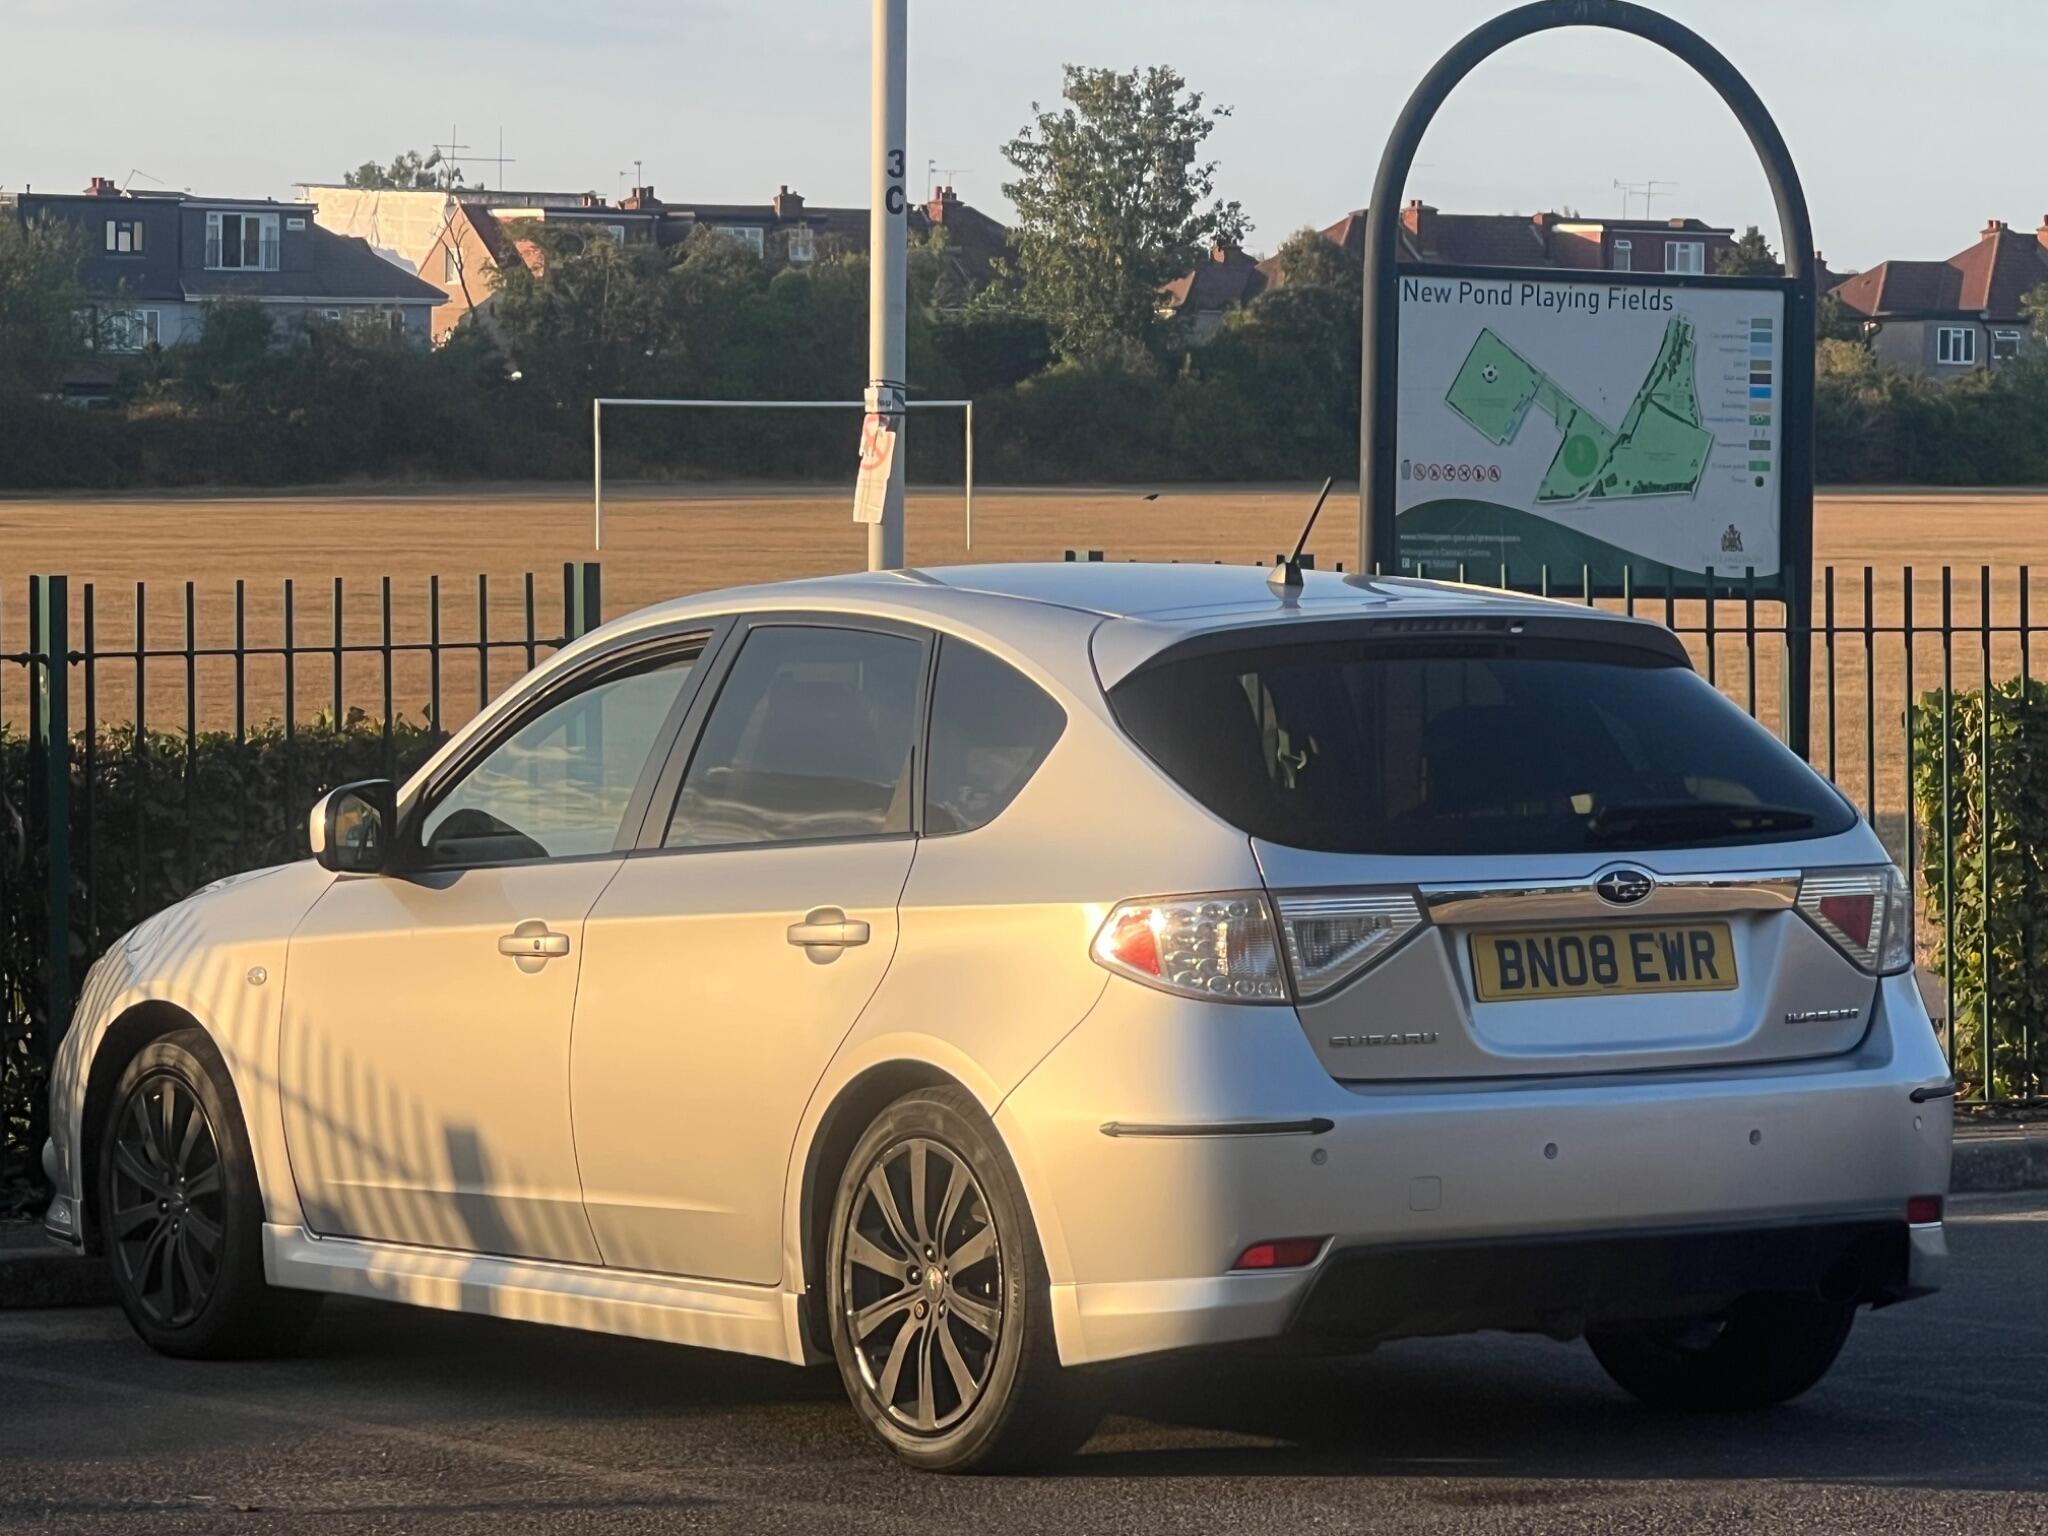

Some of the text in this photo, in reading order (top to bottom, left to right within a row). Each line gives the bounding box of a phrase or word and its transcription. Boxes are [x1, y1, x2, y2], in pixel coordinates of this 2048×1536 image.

[888, 149, 904, 178] 3
[885, 185, 903, 215] C
[1404, 279, 1673, 314] New Pond Playing Fields
[1494, 930, 1719, 990] BN08 EWR
[1329, 1032, 1440, 1048] SUBARU
